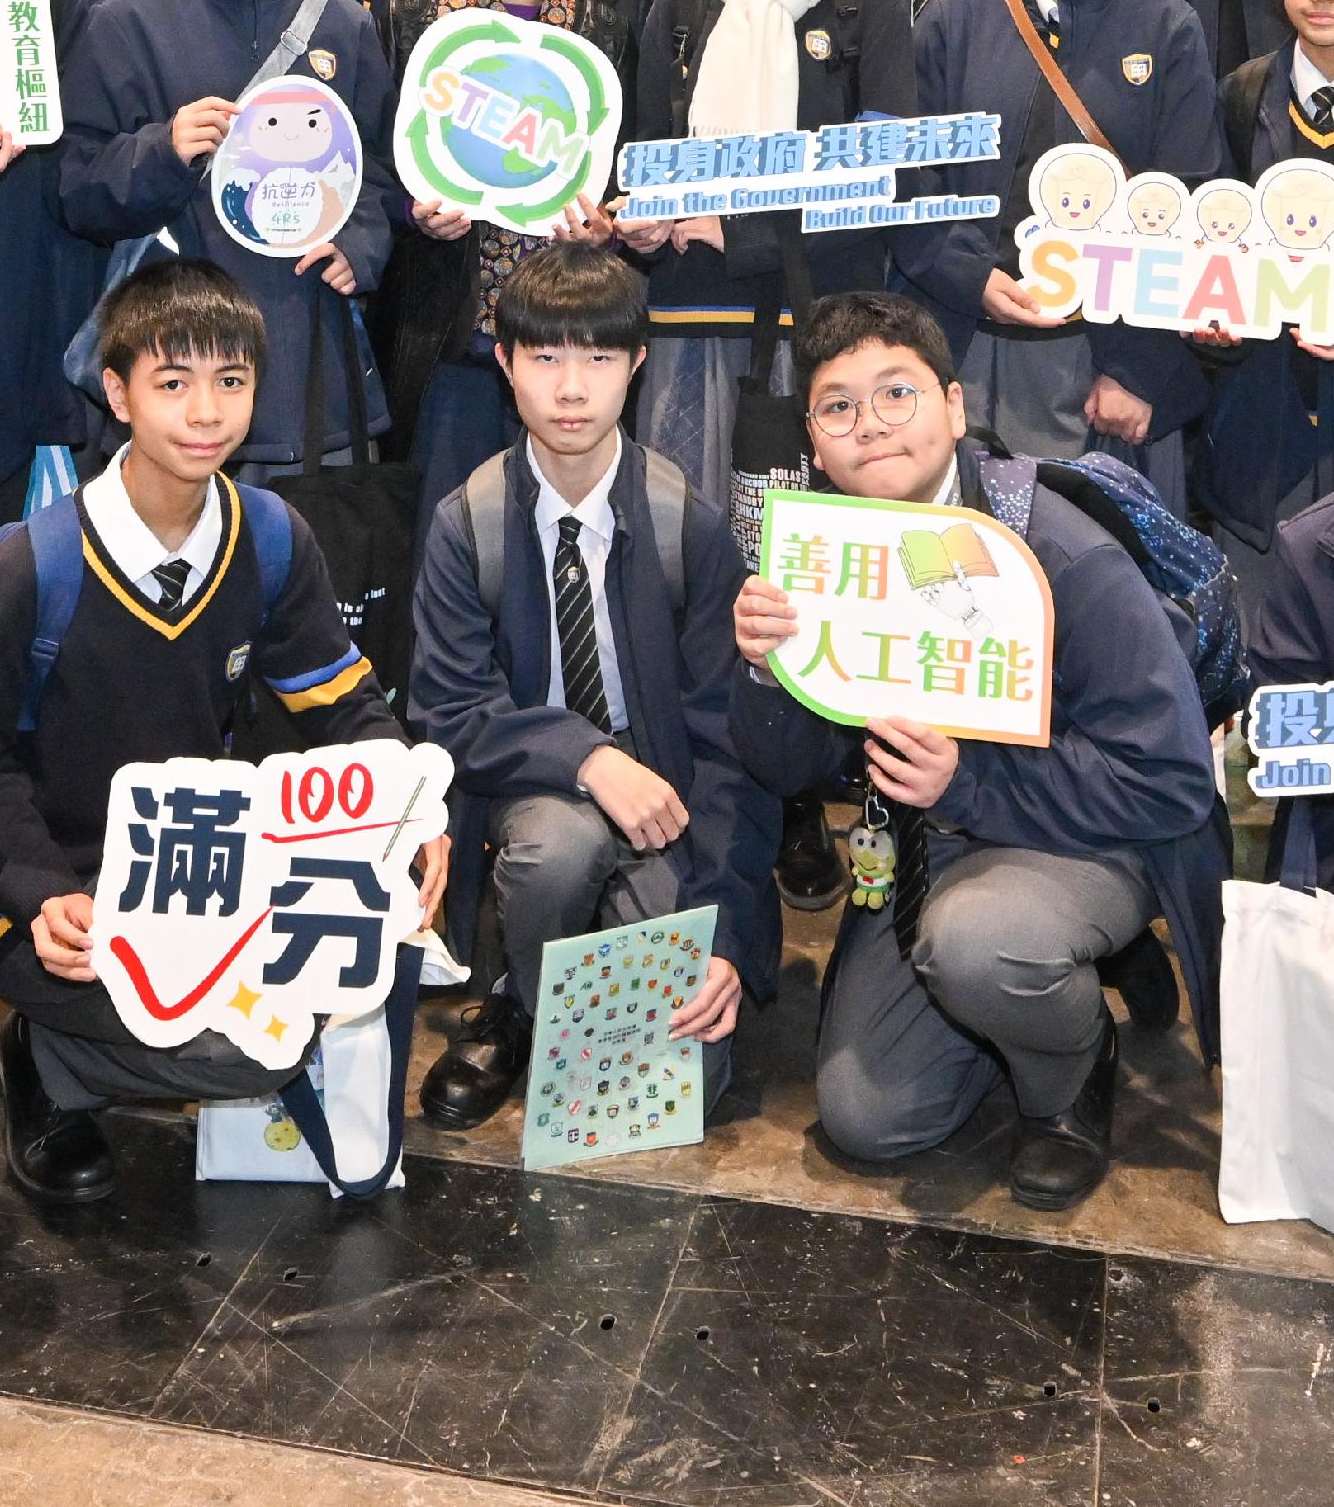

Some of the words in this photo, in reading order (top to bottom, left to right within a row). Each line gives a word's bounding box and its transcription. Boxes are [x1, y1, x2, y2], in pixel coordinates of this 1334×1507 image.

[422, 67, 592, 176] STEAM
[623, 130, 807, 190] 投身政府
[813, 112, 1001, 171] 共建未來
[620, 195, 679, 220] Join
[681, 190, 729, 215] the
[731, 176, 892, 211] Government
[805, 204, 865, 231] Build
[867, 201, 913, 225] Our
[914, 193, 997, 220] Future
[1030, 239, 1332, 334] STEAM
[769, 468, 801, 482] SOLAS
[777, 533, 889, 600] 善用
[797, 620, 1034, 702] 人工智能
[281, 763, 374, 824] 100
[1256, 759, 1331, 789] Join
[119, 786, 391, 988] 滿分
